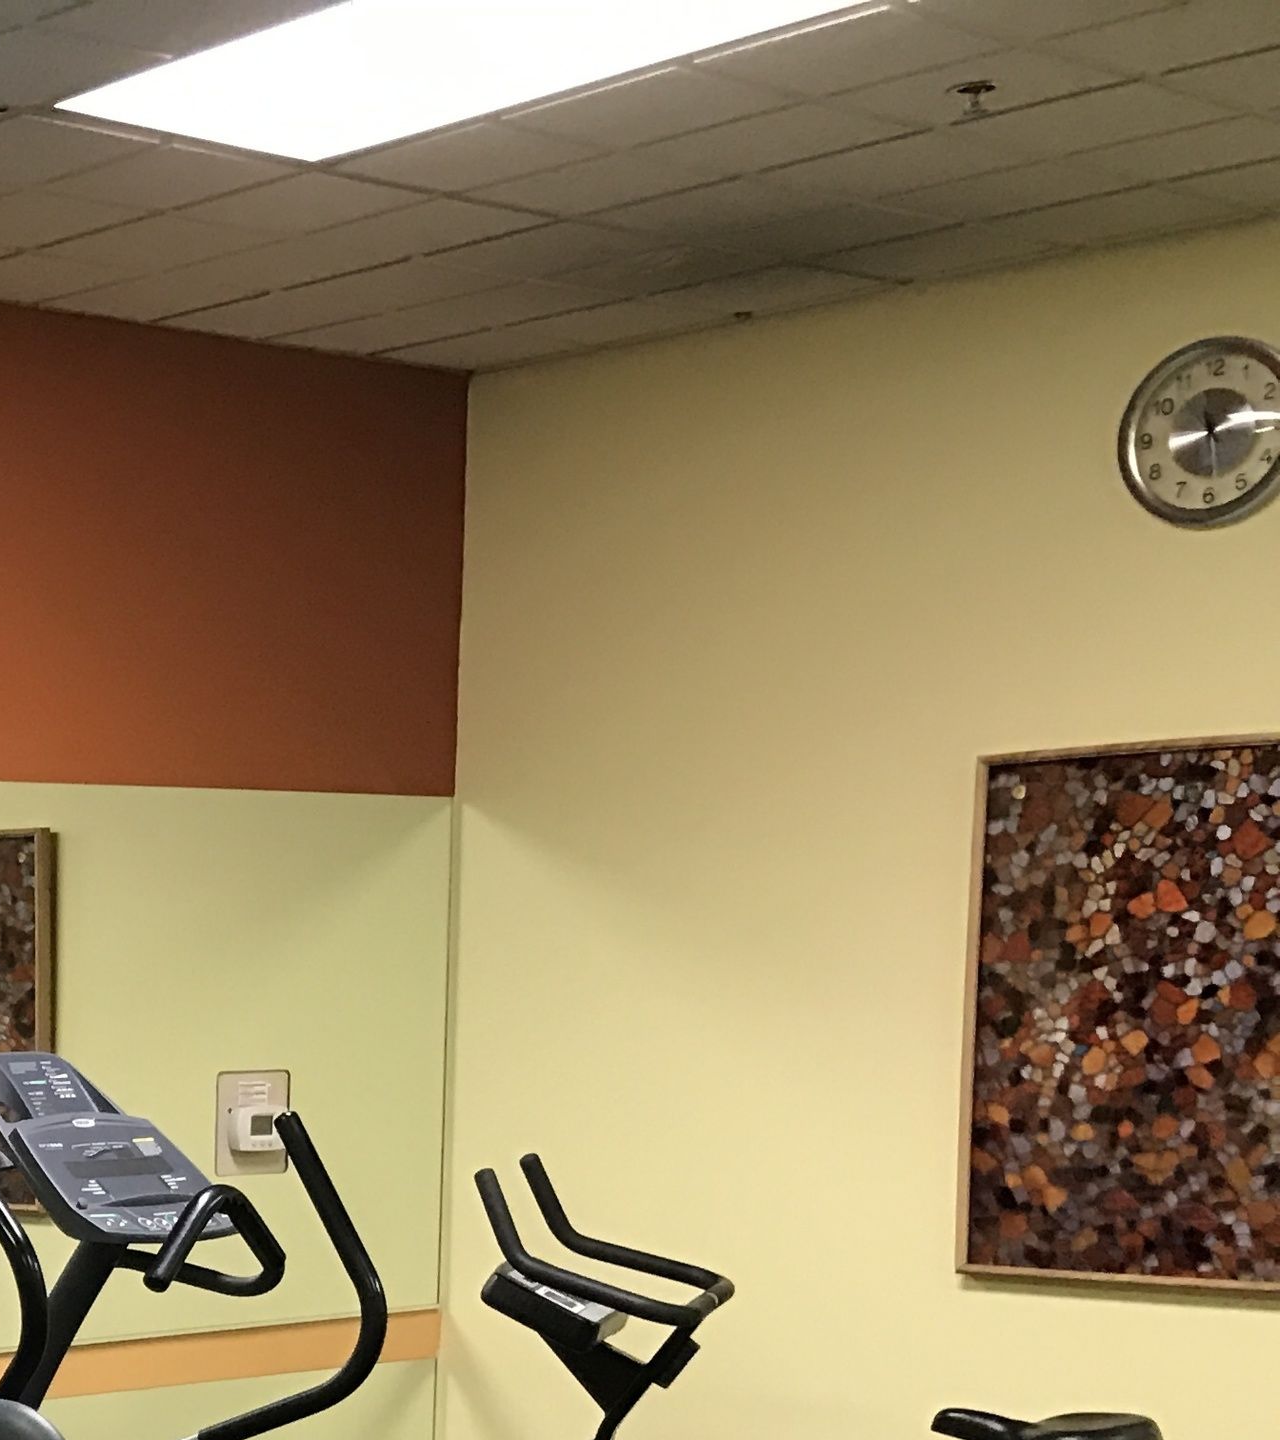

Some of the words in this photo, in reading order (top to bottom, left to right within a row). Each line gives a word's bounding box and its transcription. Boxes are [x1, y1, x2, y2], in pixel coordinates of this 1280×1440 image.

[1206, 358, 1225, 377] 12
[1243, 364, 1251, 380] 1
[1176, 374, 1193, 390] 11
[1264, 382, 1276, 400] 2
[1153, 397, 1175, 417] 10
[1140, 432, 1153, 450] 9
[1149, 463, 1162, 481] 8
[1175, 481, 1188, 499] 7
[1235, 473, 1248, 491] 5
[1203, 487, 1215, 504] 6
